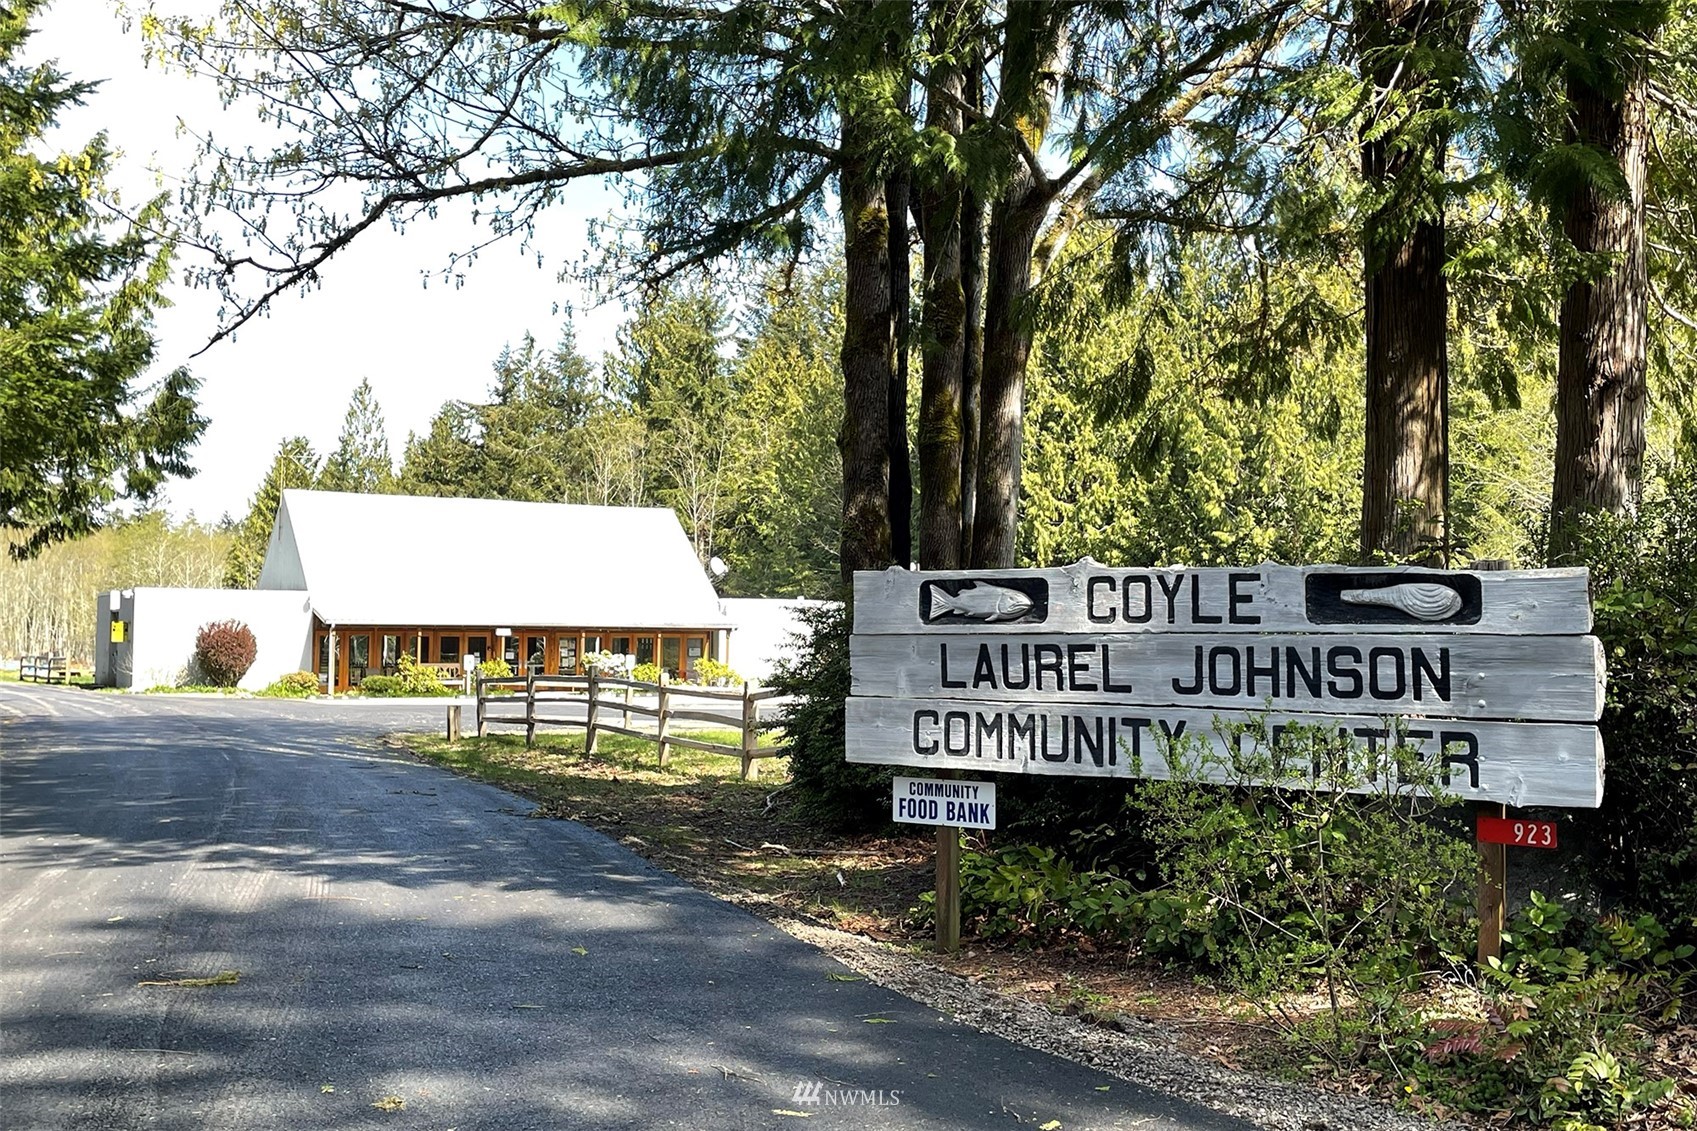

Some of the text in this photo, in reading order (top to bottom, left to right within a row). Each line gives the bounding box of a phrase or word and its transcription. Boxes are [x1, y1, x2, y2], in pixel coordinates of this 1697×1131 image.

[1087, 574, 1262, 625] COYLE
[940, 643, 1452, 702] LAUREL JOHNSON
[912, 709, 1187, 771] COMMUNITY
[909, 782, 979, 799] COMMUNITY
[899, 798, 990, 824] FOOD BANK
[1514, 822, 1551, 846] 923
